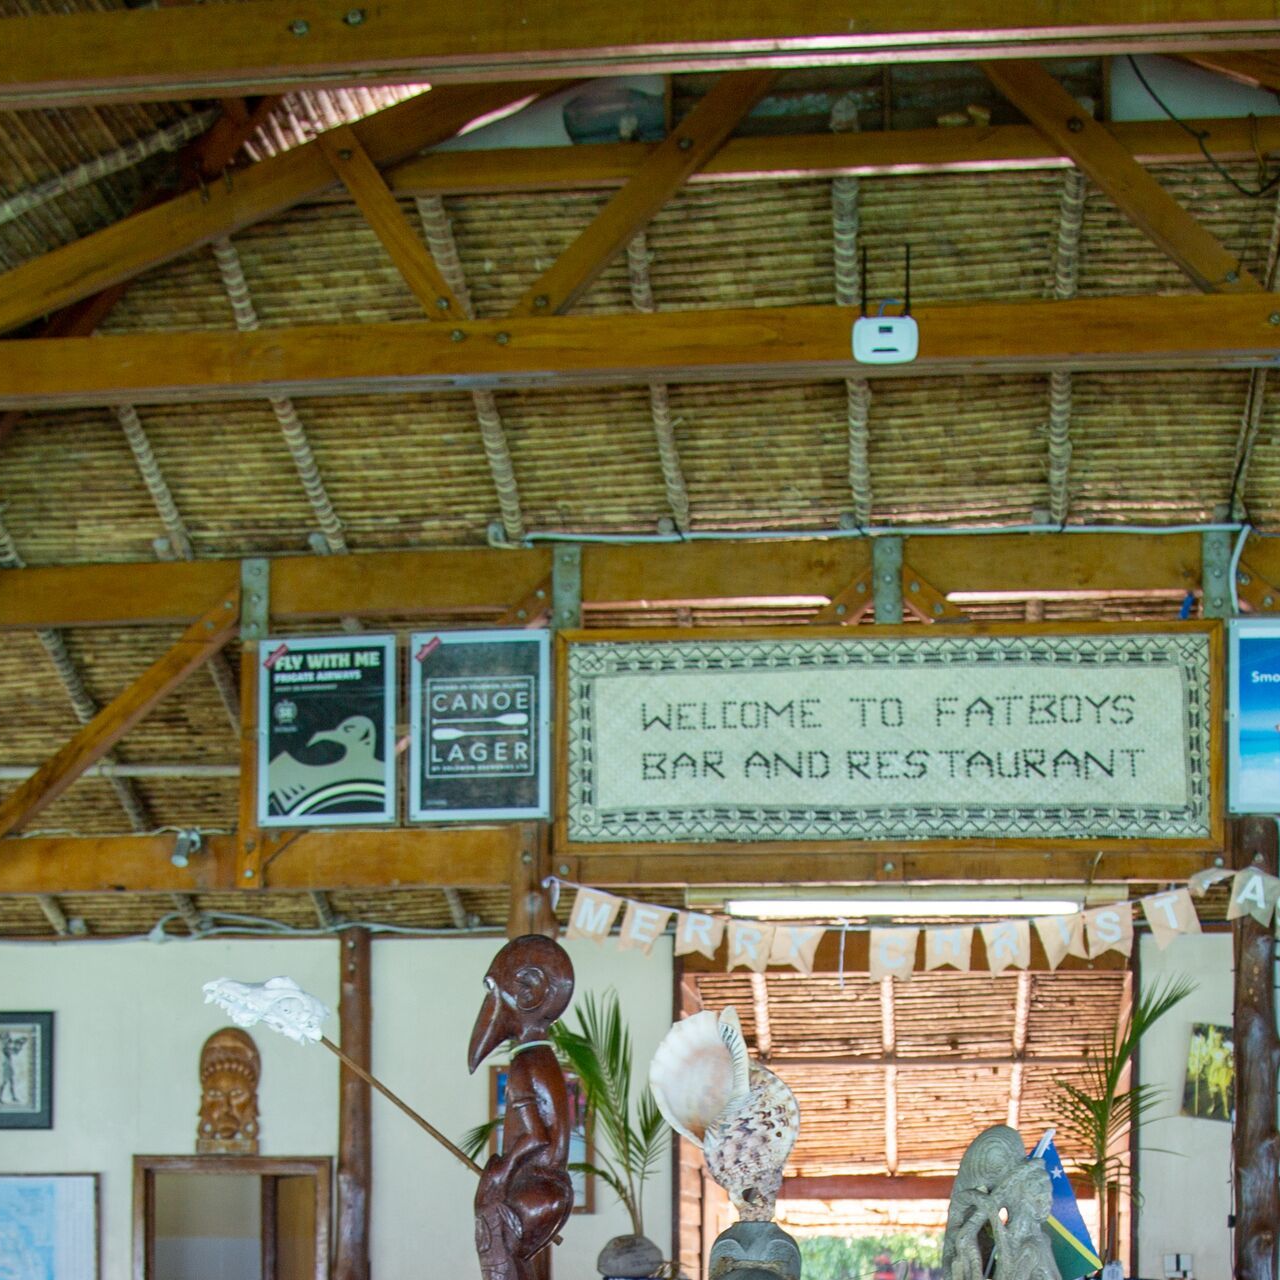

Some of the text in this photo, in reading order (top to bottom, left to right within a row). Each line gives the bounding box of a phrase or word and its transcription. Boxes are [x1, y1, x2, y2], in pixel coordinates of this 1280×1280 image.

[275, 655, 303, 671] FLY
[306, 652, 351, 669] WITH
[354, 651, 380, 667] ME
[432, 691, 528, 712] CANOE
[642, 694, 1135, 731] WELCOME TO FATBOYS
[431, 741, 528, 762] LAGER
[642, 748, 1146, 781] BAR AND RESTAURANT
[575, 896, 812, 960] MERRY
